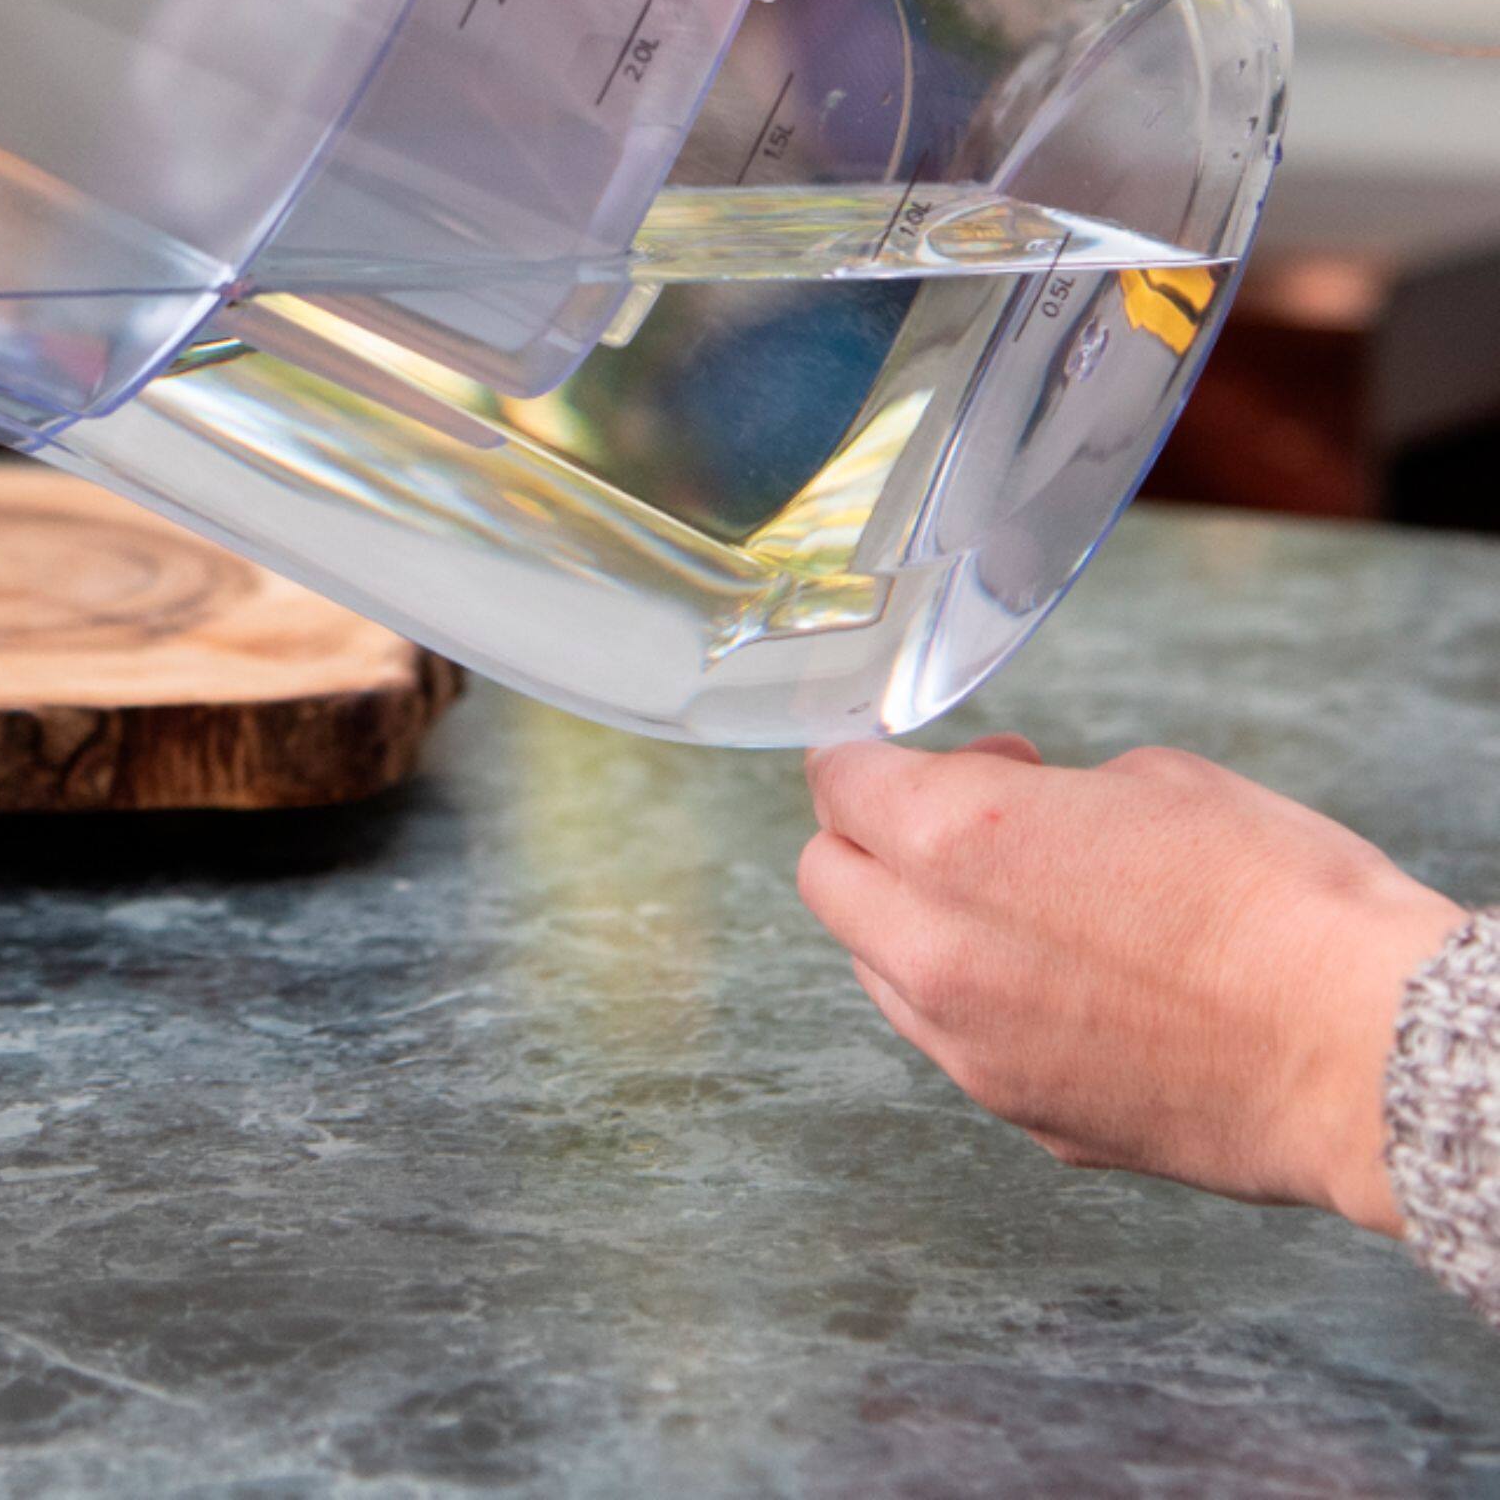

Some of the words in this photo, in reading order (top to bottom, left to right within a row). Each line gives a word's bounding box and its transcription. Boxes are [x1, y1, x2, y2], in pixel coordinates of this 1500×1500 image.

[623, 38, 660, 83] 2.0L
[763, 125, 796, 160] 1.5L
[899, 201, 932, 238] 1.0L
[1041, 276, 1075, 318] 0.5L
